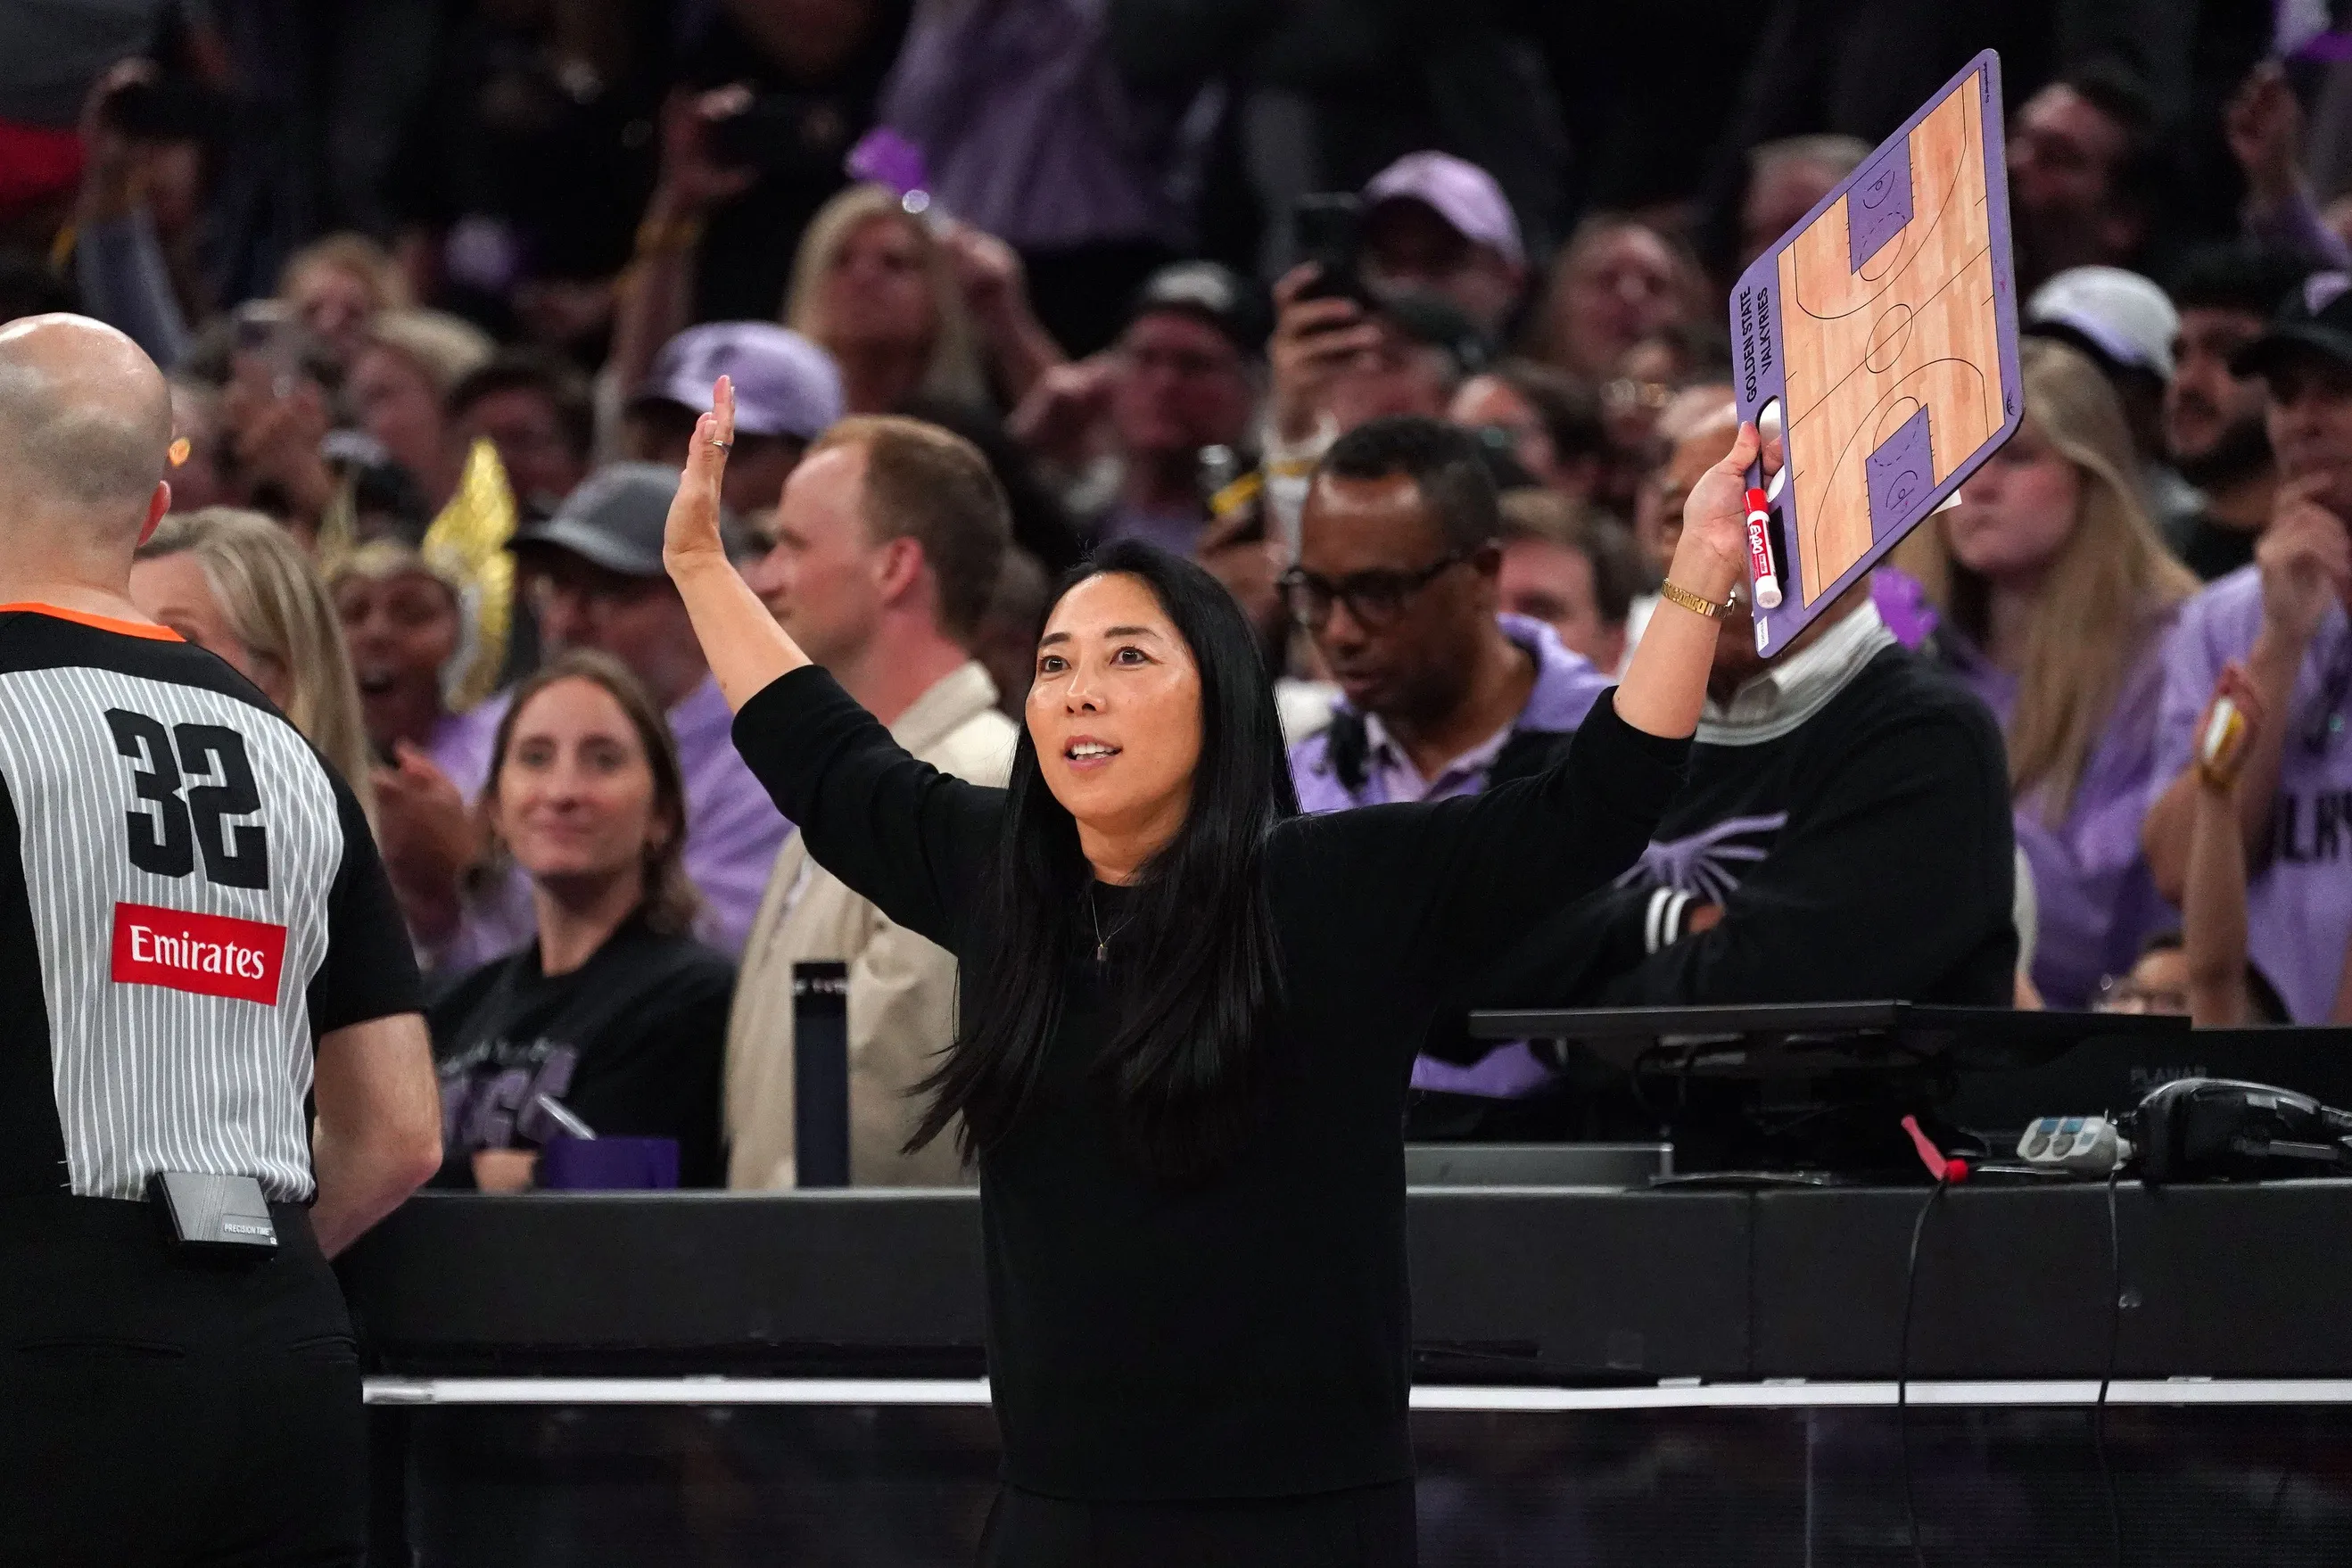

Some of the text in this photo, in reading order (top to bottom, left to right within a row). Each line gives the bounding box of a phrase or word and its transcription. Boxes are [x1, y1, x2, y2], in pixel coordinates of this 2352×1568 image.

[1740, 285, 1757, 403] GOLDEN STATE
[1757, 286, 1772, 375] VALKYRIES
[1749, 524, 1764, 554] EXPO
[104, 708, 268, 890] 32
[129, 925, 265, 980] Emirates
[224, 1223, 270, 1236] PRECISION TIME
